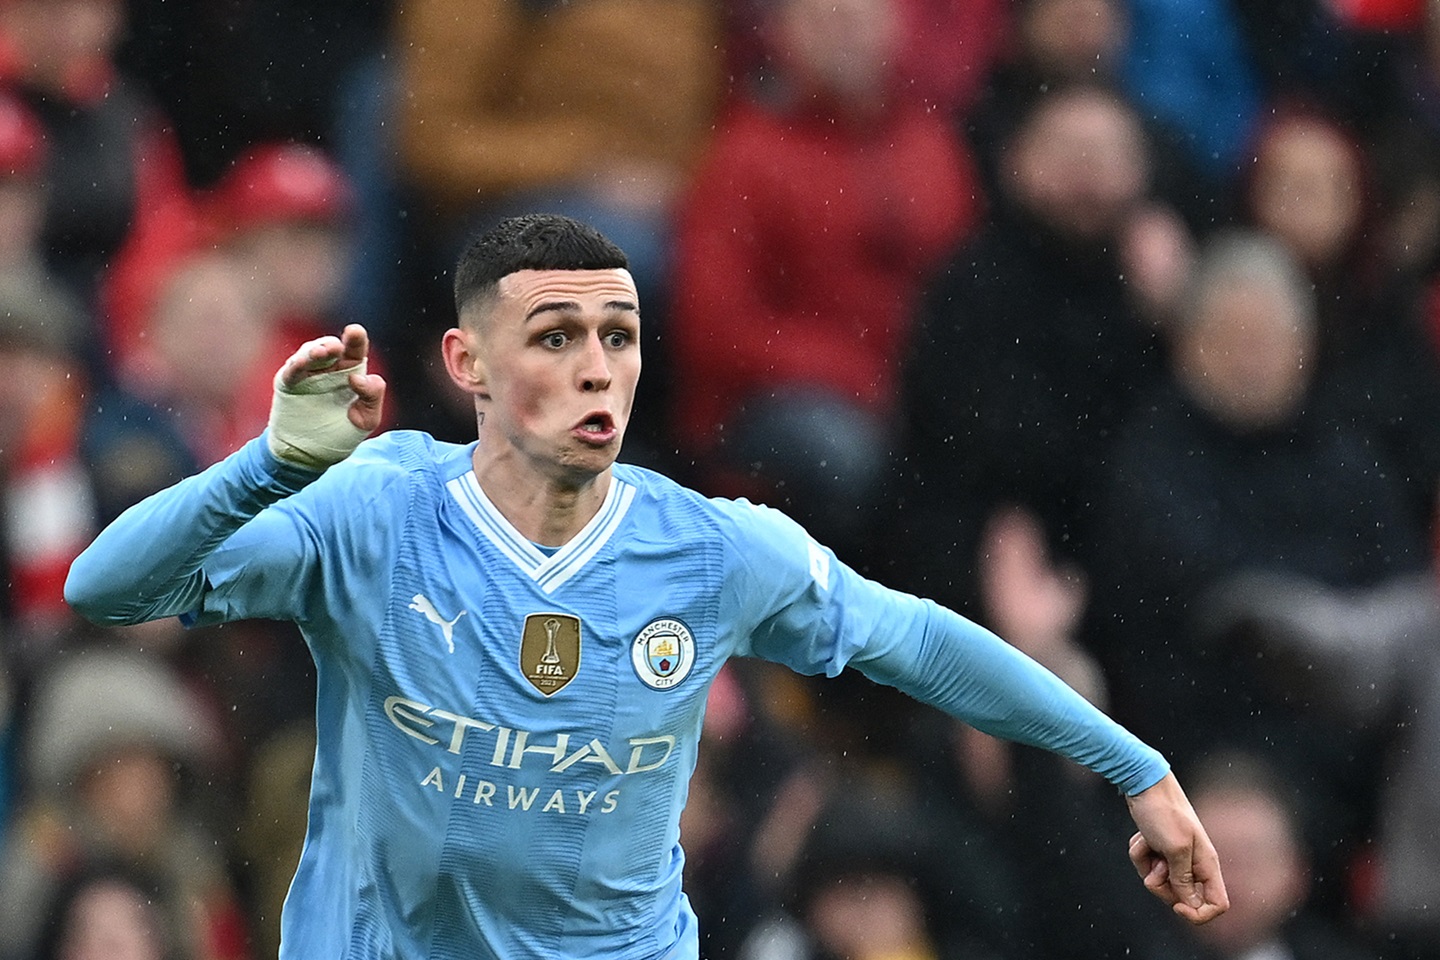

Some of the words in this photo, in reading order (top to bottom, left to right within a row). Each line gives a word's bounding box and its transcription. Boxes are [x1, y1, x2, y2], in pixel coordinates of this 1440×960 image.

[637, 622, 690, 646] MANCHESTER
[536, 664, 563, 676] FIFA
[655, 679, 674, 687] CITY
[383, 695, 677, 776] ETIHAD
[420, 765, 621, 815] AIRWAYS
